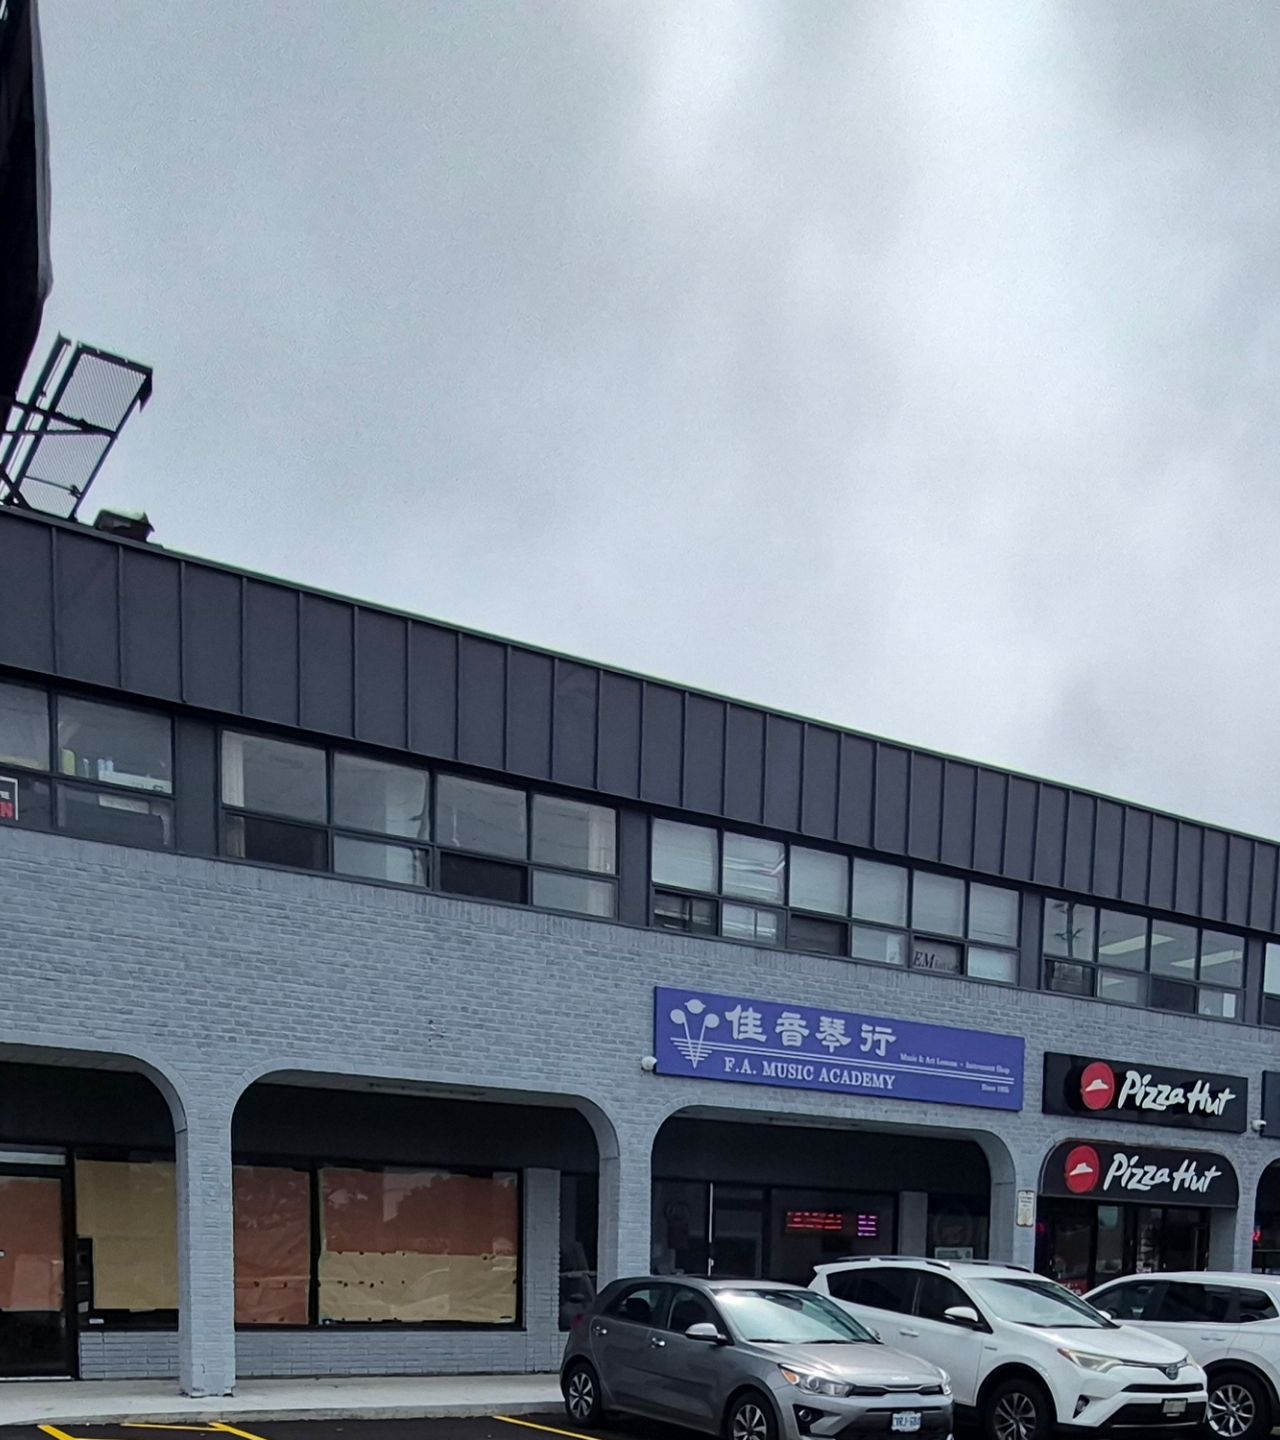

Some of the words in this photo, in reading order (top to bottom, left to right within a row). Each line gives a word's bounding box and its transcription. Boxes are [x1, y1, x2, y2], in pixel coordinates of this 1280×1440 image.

[724, 1004, 897, 1057] 佳音琴行
[724, 1056, 758, 1075] F.A.
[762, 1060, 815, 1081] MUSIC
[819, 1067, 896, 1090] ACADEMY
[1117, 1070, 1186, 1111] Pizza
[1186, 1079, 1237, 1116] Hut
[1102, 1152, 1171, 1192] Pizza
[1171, 1159, 1223, 1193] Hut
